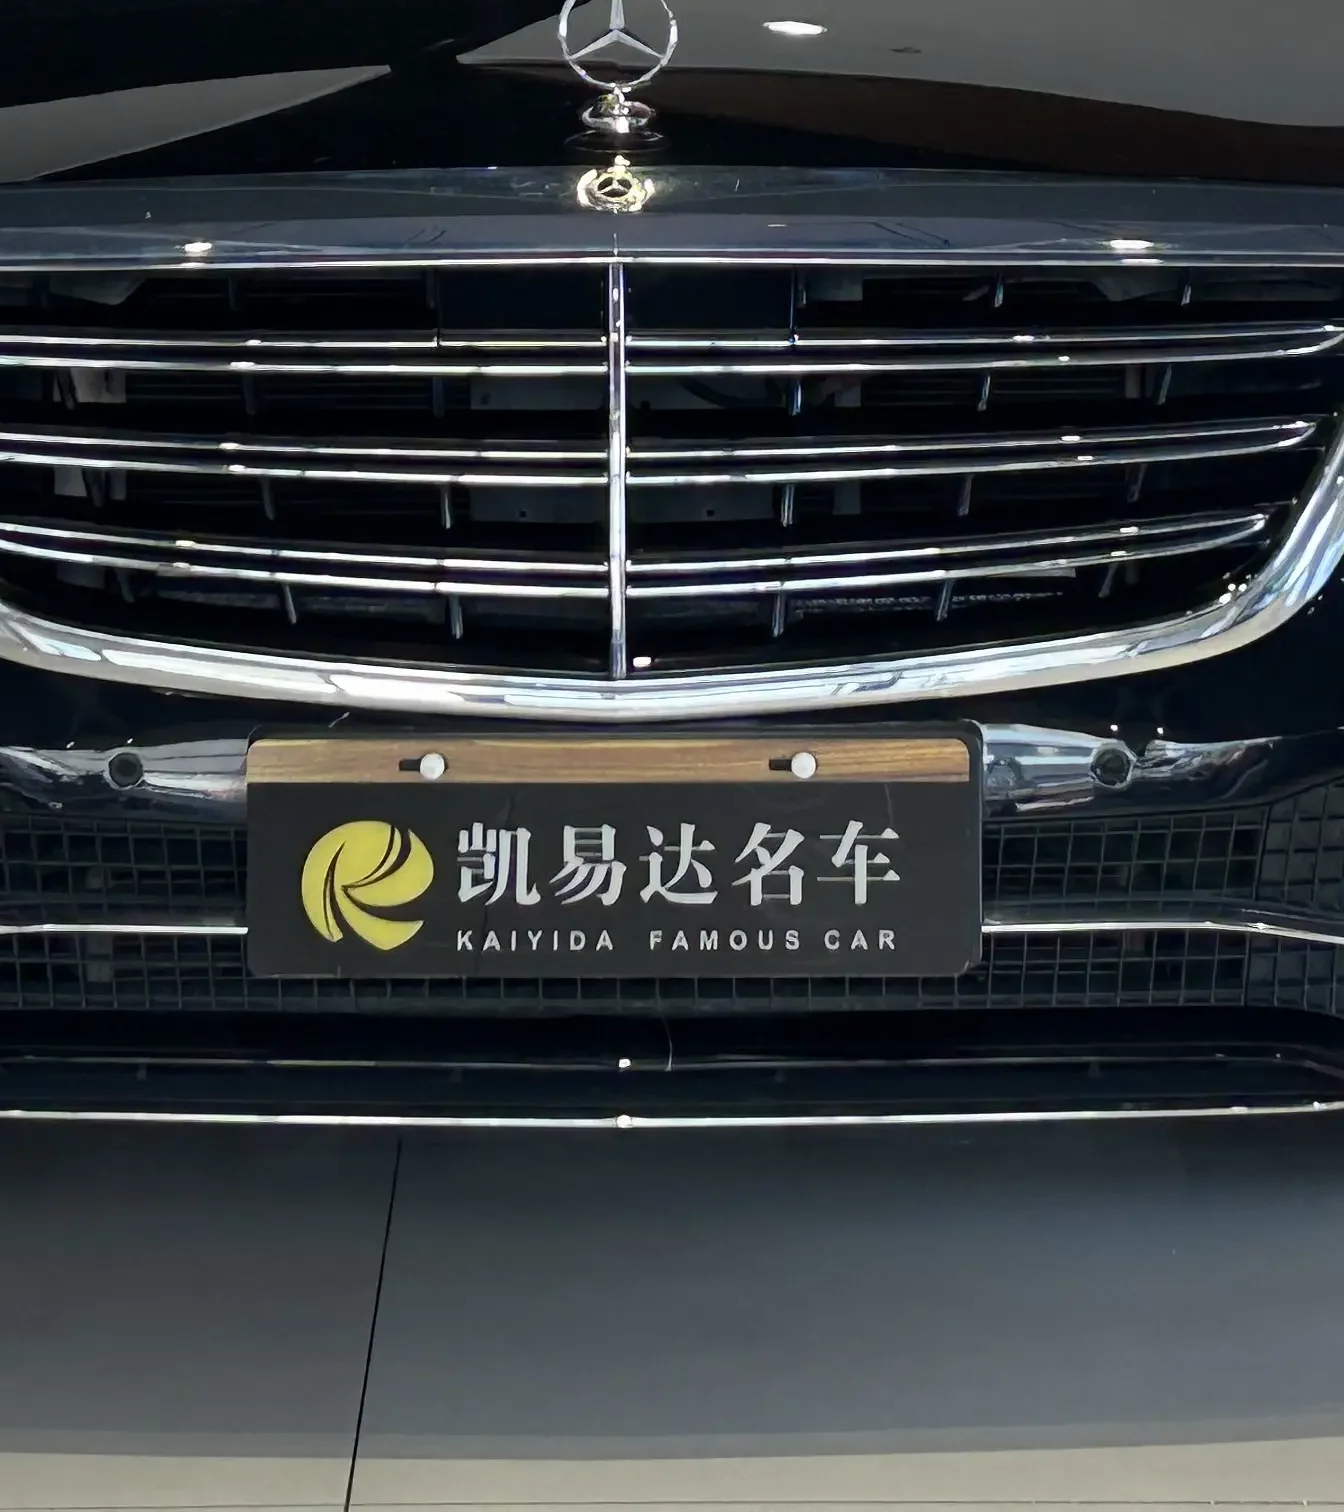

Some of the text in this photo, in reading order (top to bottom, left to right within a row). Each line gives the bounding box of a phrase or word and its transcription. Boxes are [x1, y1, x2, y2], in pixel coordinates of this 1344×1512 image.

[457, 819, 901, 907] 凯易达名车
[456, 929, 897, 952] KAIYIDA FAMOUS CAR
